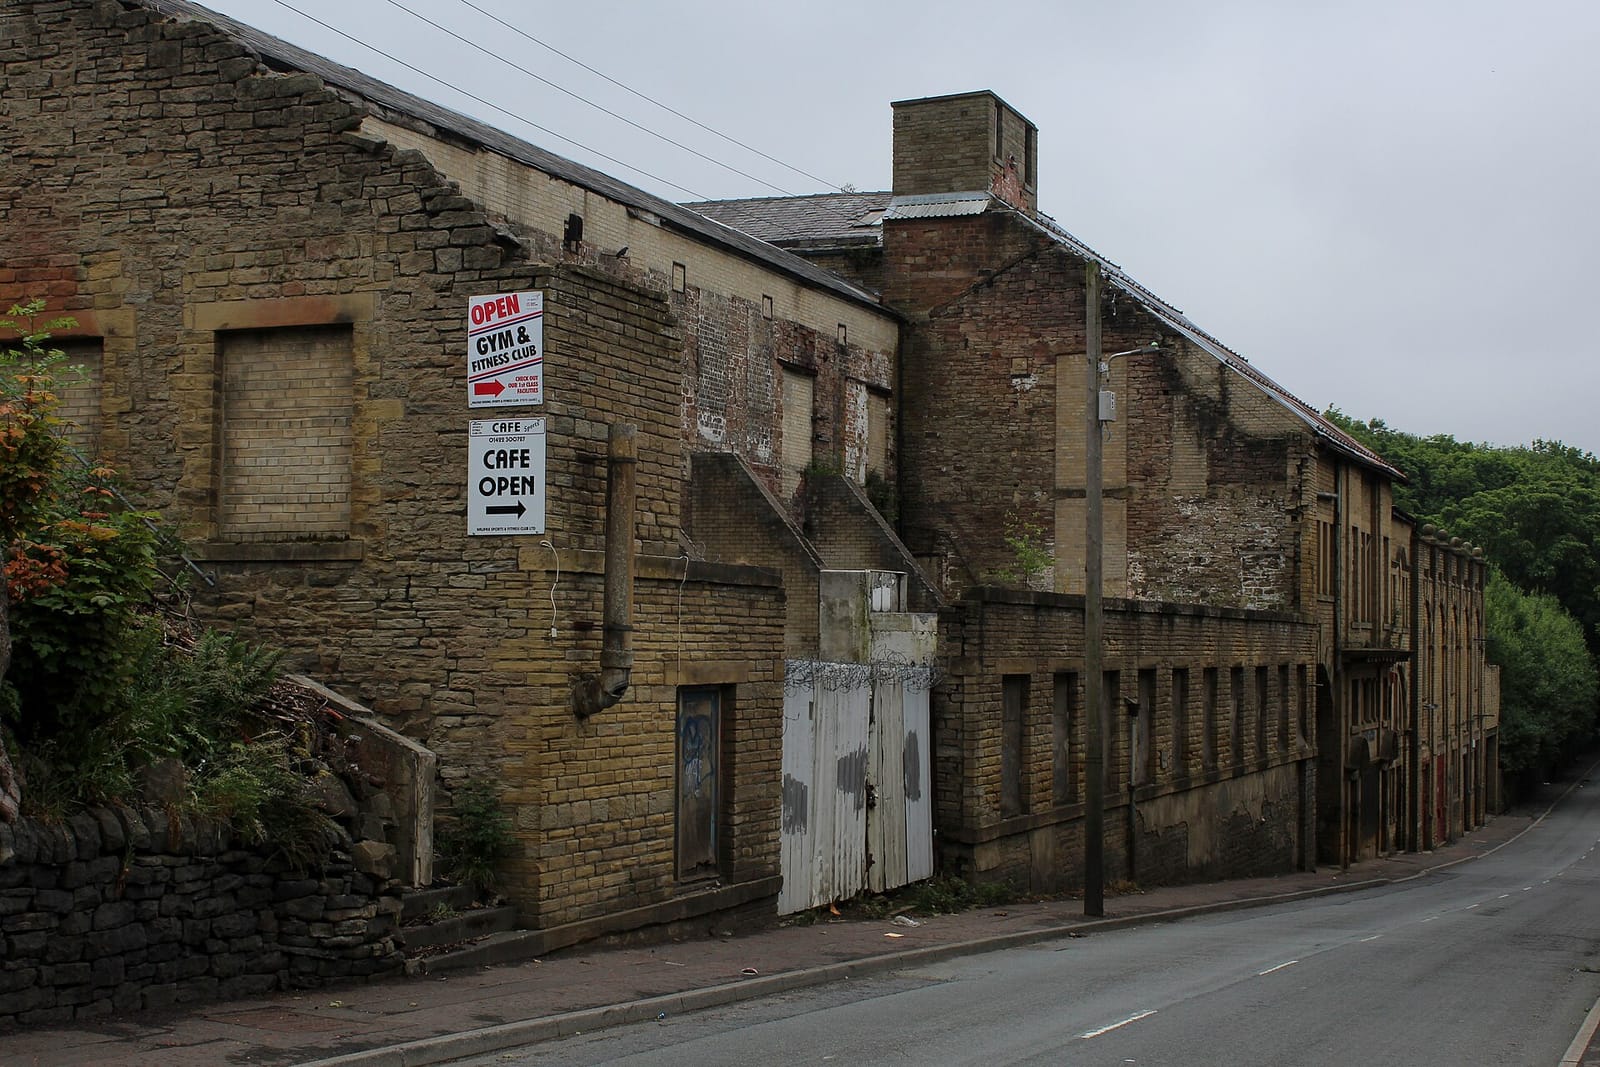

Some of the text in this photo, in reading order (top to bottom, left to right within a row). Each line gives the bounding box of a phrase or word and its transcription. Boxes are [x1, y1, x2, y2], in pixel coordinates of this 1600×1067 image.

[471, 294, 520, 326] OPEN
[476, 326, 531, 355] GYM &
[471, 345, 537, 373] FITNESS CLUB
[492, 422, 521, 433] CAFE
[524, 421, 540, 433] Sports
[483, 449, 530, 469] CAFE
[479, 476, 535, 497] OPEN
